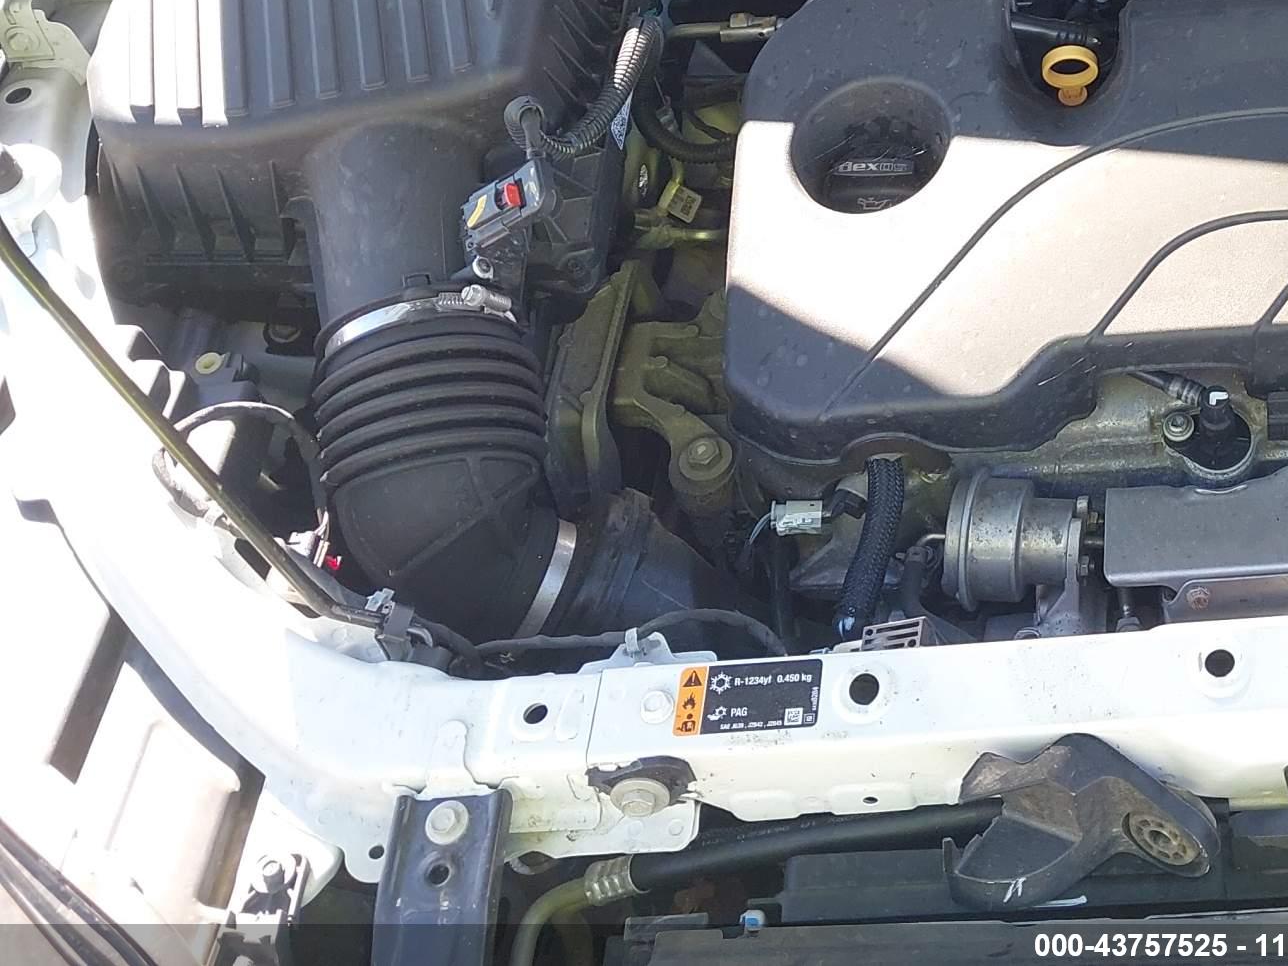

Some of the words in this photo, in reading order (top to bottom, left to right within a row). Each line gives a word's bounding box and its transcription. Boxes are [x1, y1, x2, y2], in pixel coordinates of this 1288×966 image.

[734, 675, 772, 687] R-1234yf
[776, 674, 800, 684] 0.450
[801, 674, 813, 683] kg
[730, 707, 748, 717] PAG
